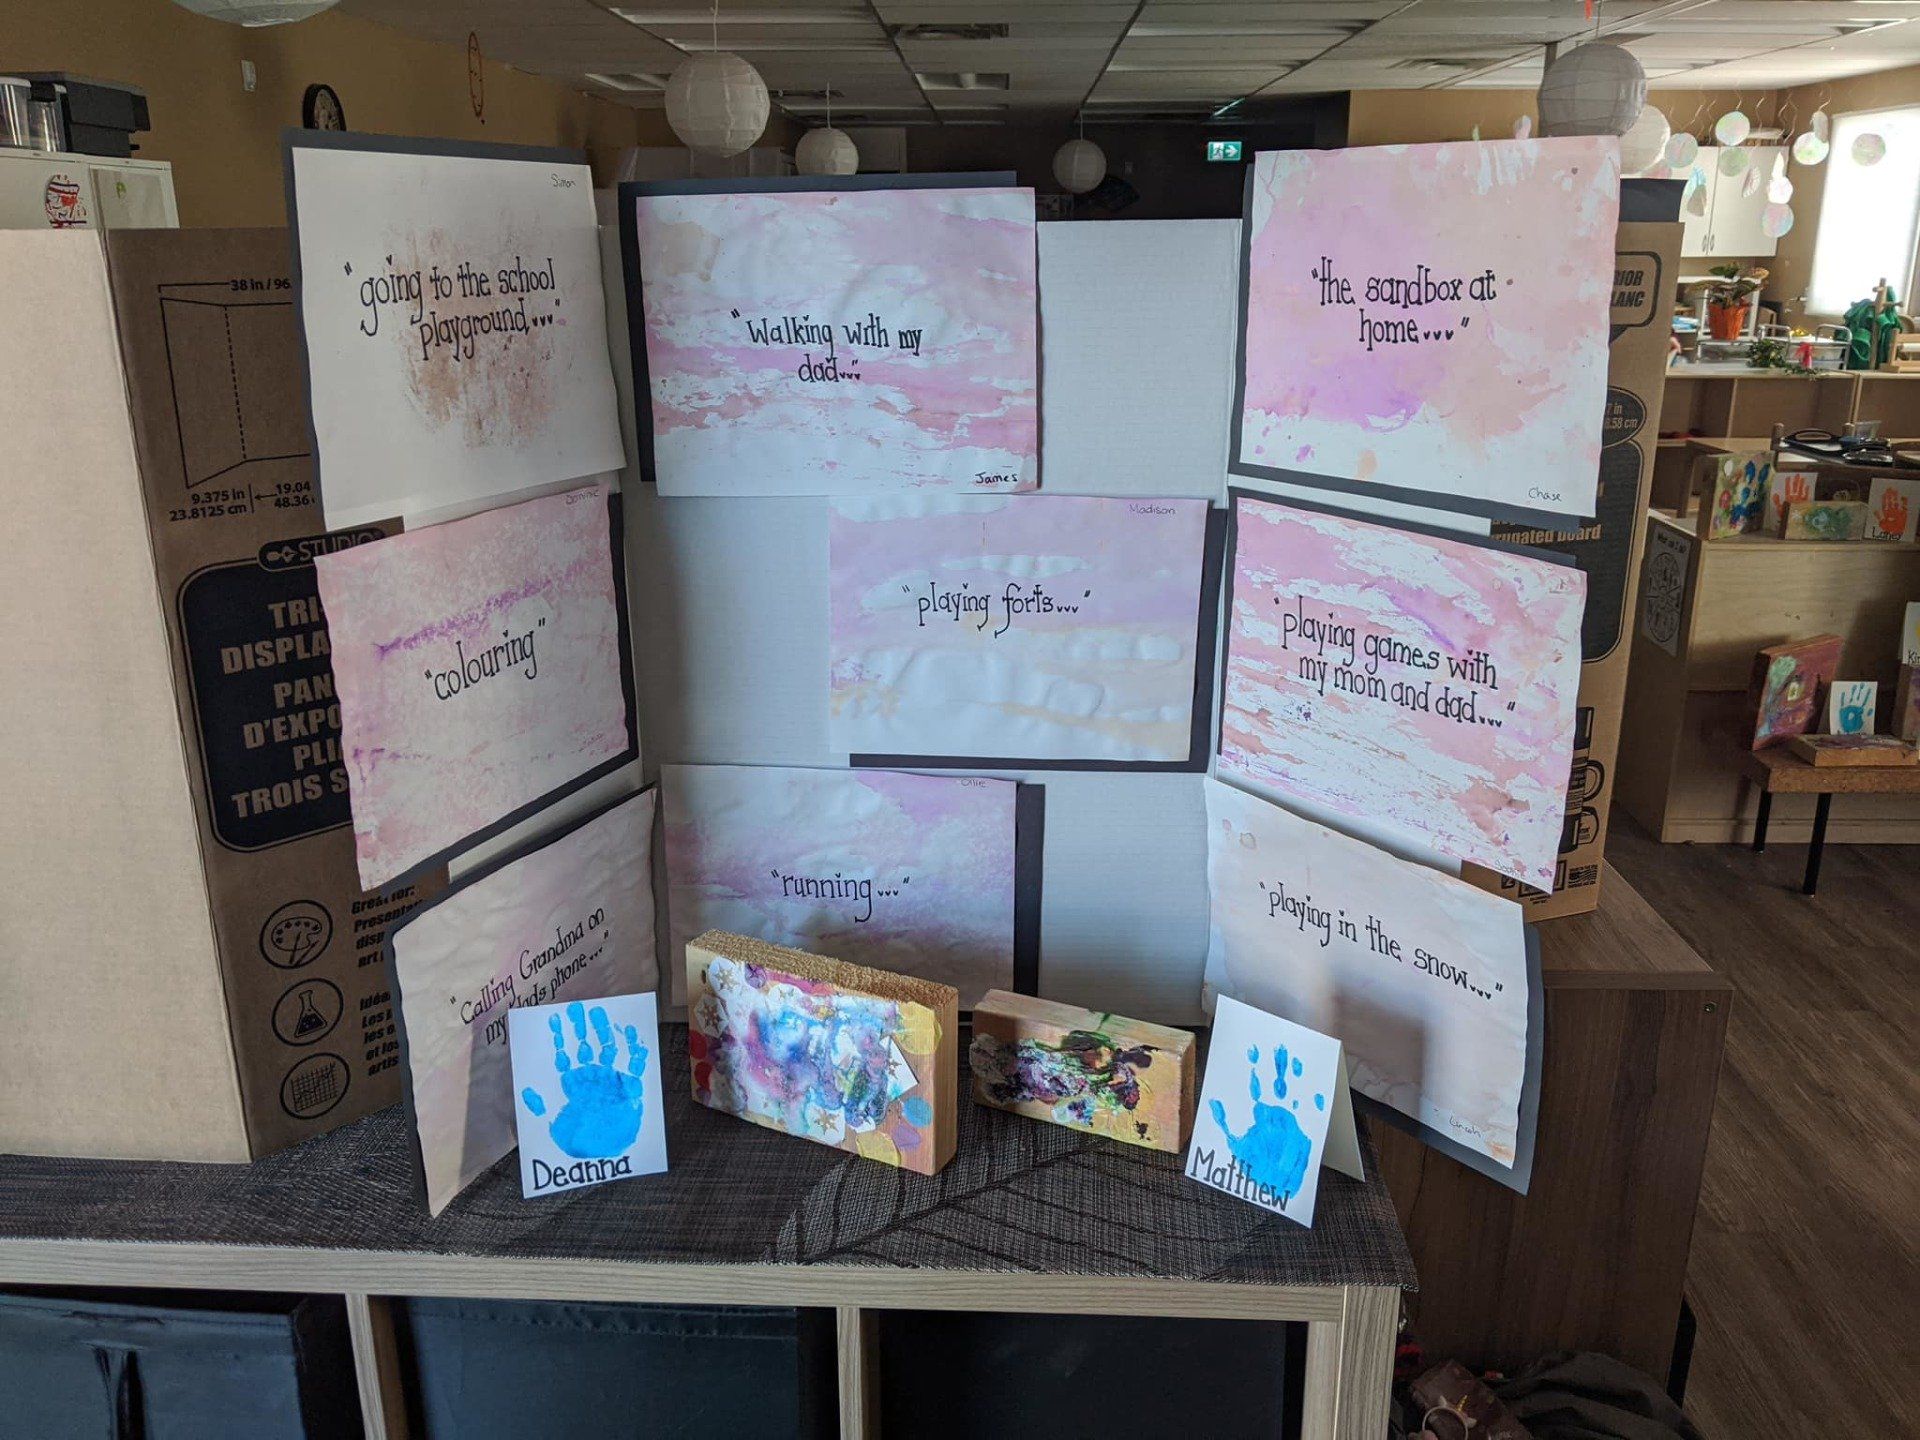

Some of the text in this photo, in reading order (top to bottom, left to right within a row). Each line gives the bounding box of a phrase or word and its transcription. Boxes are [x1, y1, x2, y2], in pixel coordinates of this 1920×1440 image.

[231, 279, 249, 291] 38
[250, 278, 264, 290] in
[430, 265, 453, 301] to
[457, 261, 492, 299] the
[498, 256, 557, 295] school
[1365, 264, 1463, 309] sandbox
[1469, 269, 1498, 301] at
[842, 313, 890, 347] with
[898, 327, 922, 356] my
[1624, 418, 1638, 429] cm
[191, 488, 245, 505] 9.375 in
[975, 471, 1018, 484] James
[1529, 486, 1562, 501] Chase
[169, 502, 247, 522] 23.8125 cm
[1129, 503, 1176, 515] Madison
[1299, 655, 1328, 697] my
[1333, 664, 1387, 703] mom
[1390, 681, 1431, 712] and
[1363, 633, 1441, 676] games
[1446, 648, 1499, 691] with
[231, 774, 324, 819] TROIS
[519, 921, 585, 980] Grandma
[588, 907, 605, 930] on
[1339, 909, 1358, 942] in
[1365, 915, 1402, 963] the
[532, 1156, 632, 1190] Deanna
[1190, 1146, 1291, 1212] Matthew
